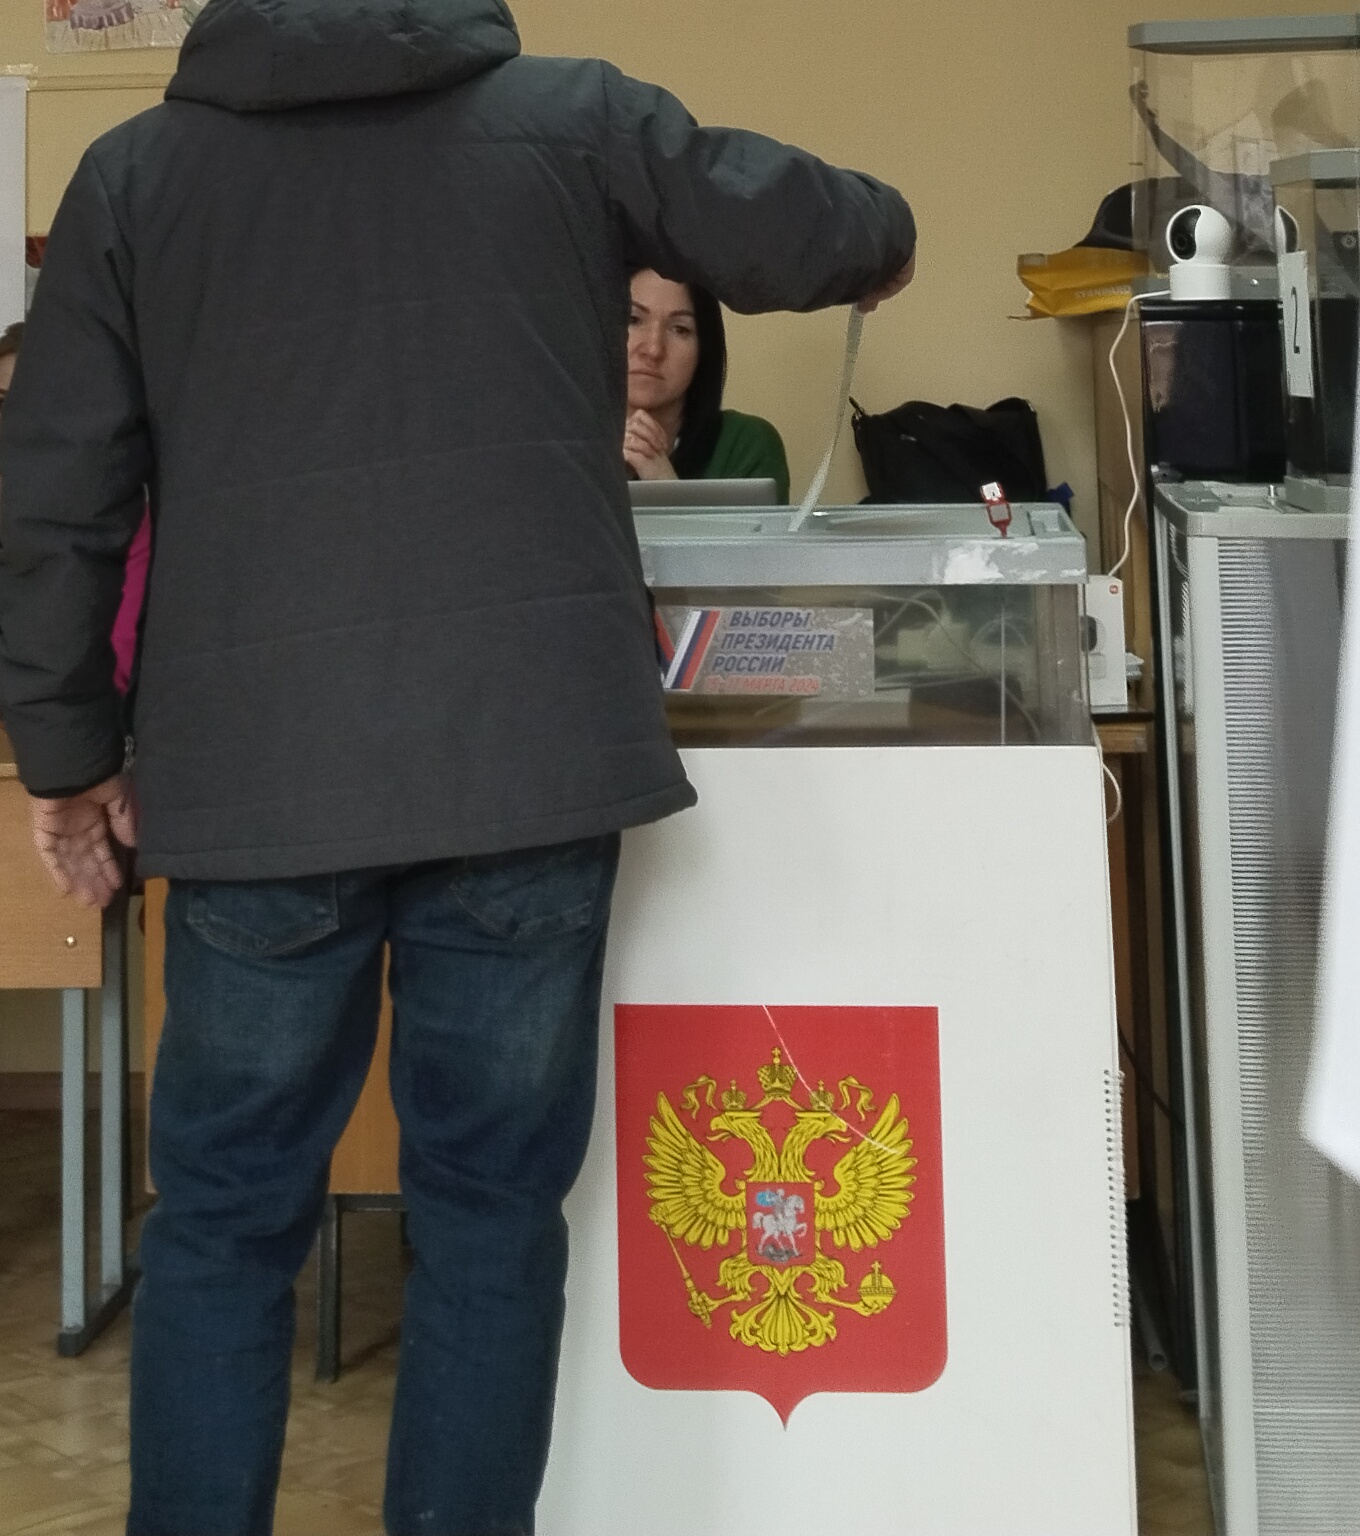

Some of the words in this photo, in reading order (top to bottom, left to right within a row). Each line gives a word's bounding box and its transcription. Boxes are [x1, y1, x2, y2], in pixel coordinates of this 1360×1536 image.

[729, 611, 811, 627] ВЫБОРЫ
[720, 633, 835, 653] ПРЕЗИДЕНТА
[711, 656, 786, 672] РОССИИ
